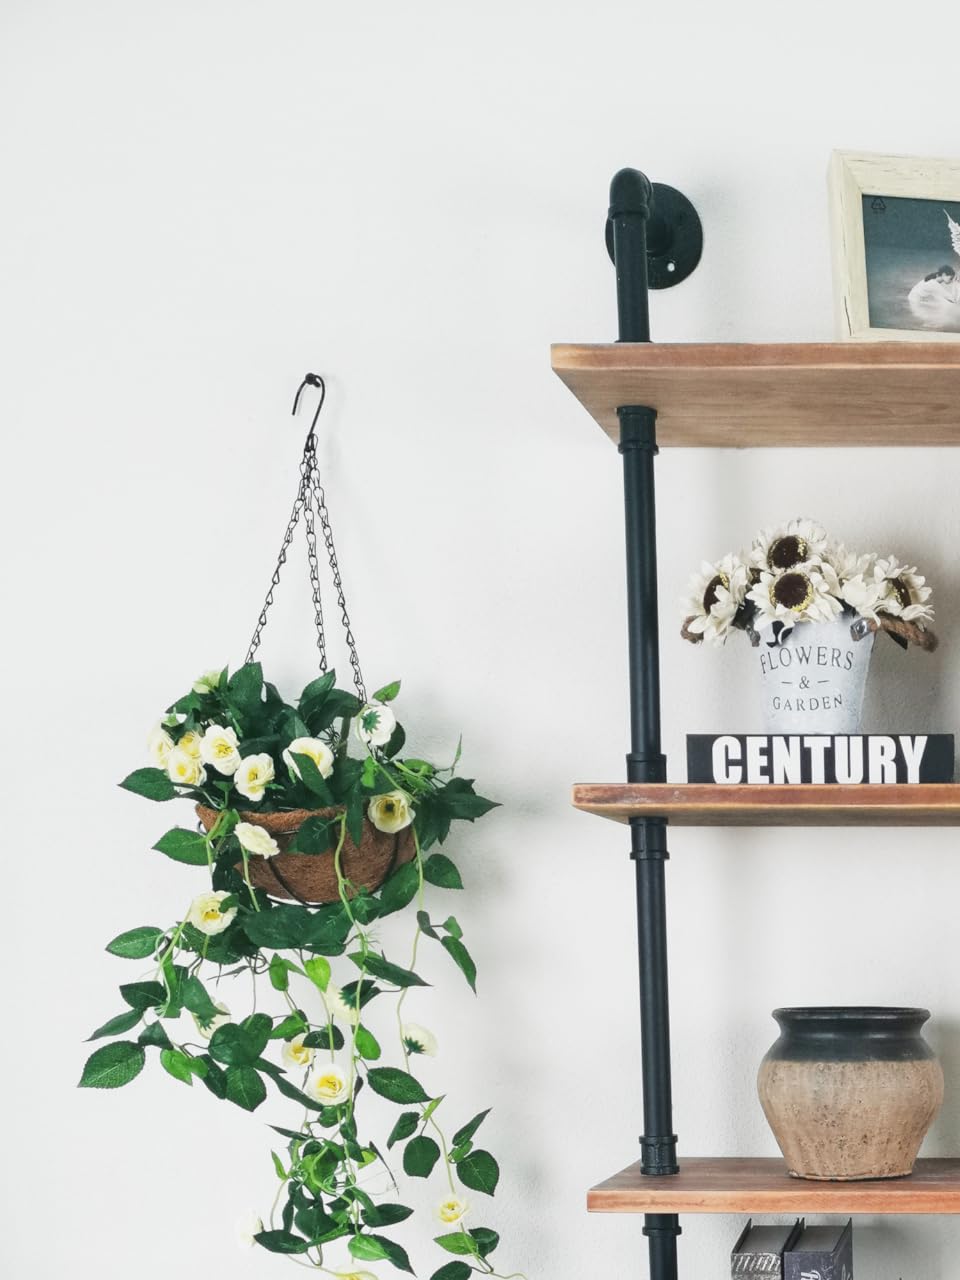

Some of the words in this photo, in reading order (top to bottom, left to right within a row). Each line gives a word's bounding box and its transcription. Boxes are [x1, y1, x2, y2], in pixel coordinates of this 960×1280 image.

[760, 646, 854, 674] FLOWERS
[798, 675, 811, 689] &
[773, 694, 844, 712] GARDEN
[711, 735, 928, 784] CENTURY
